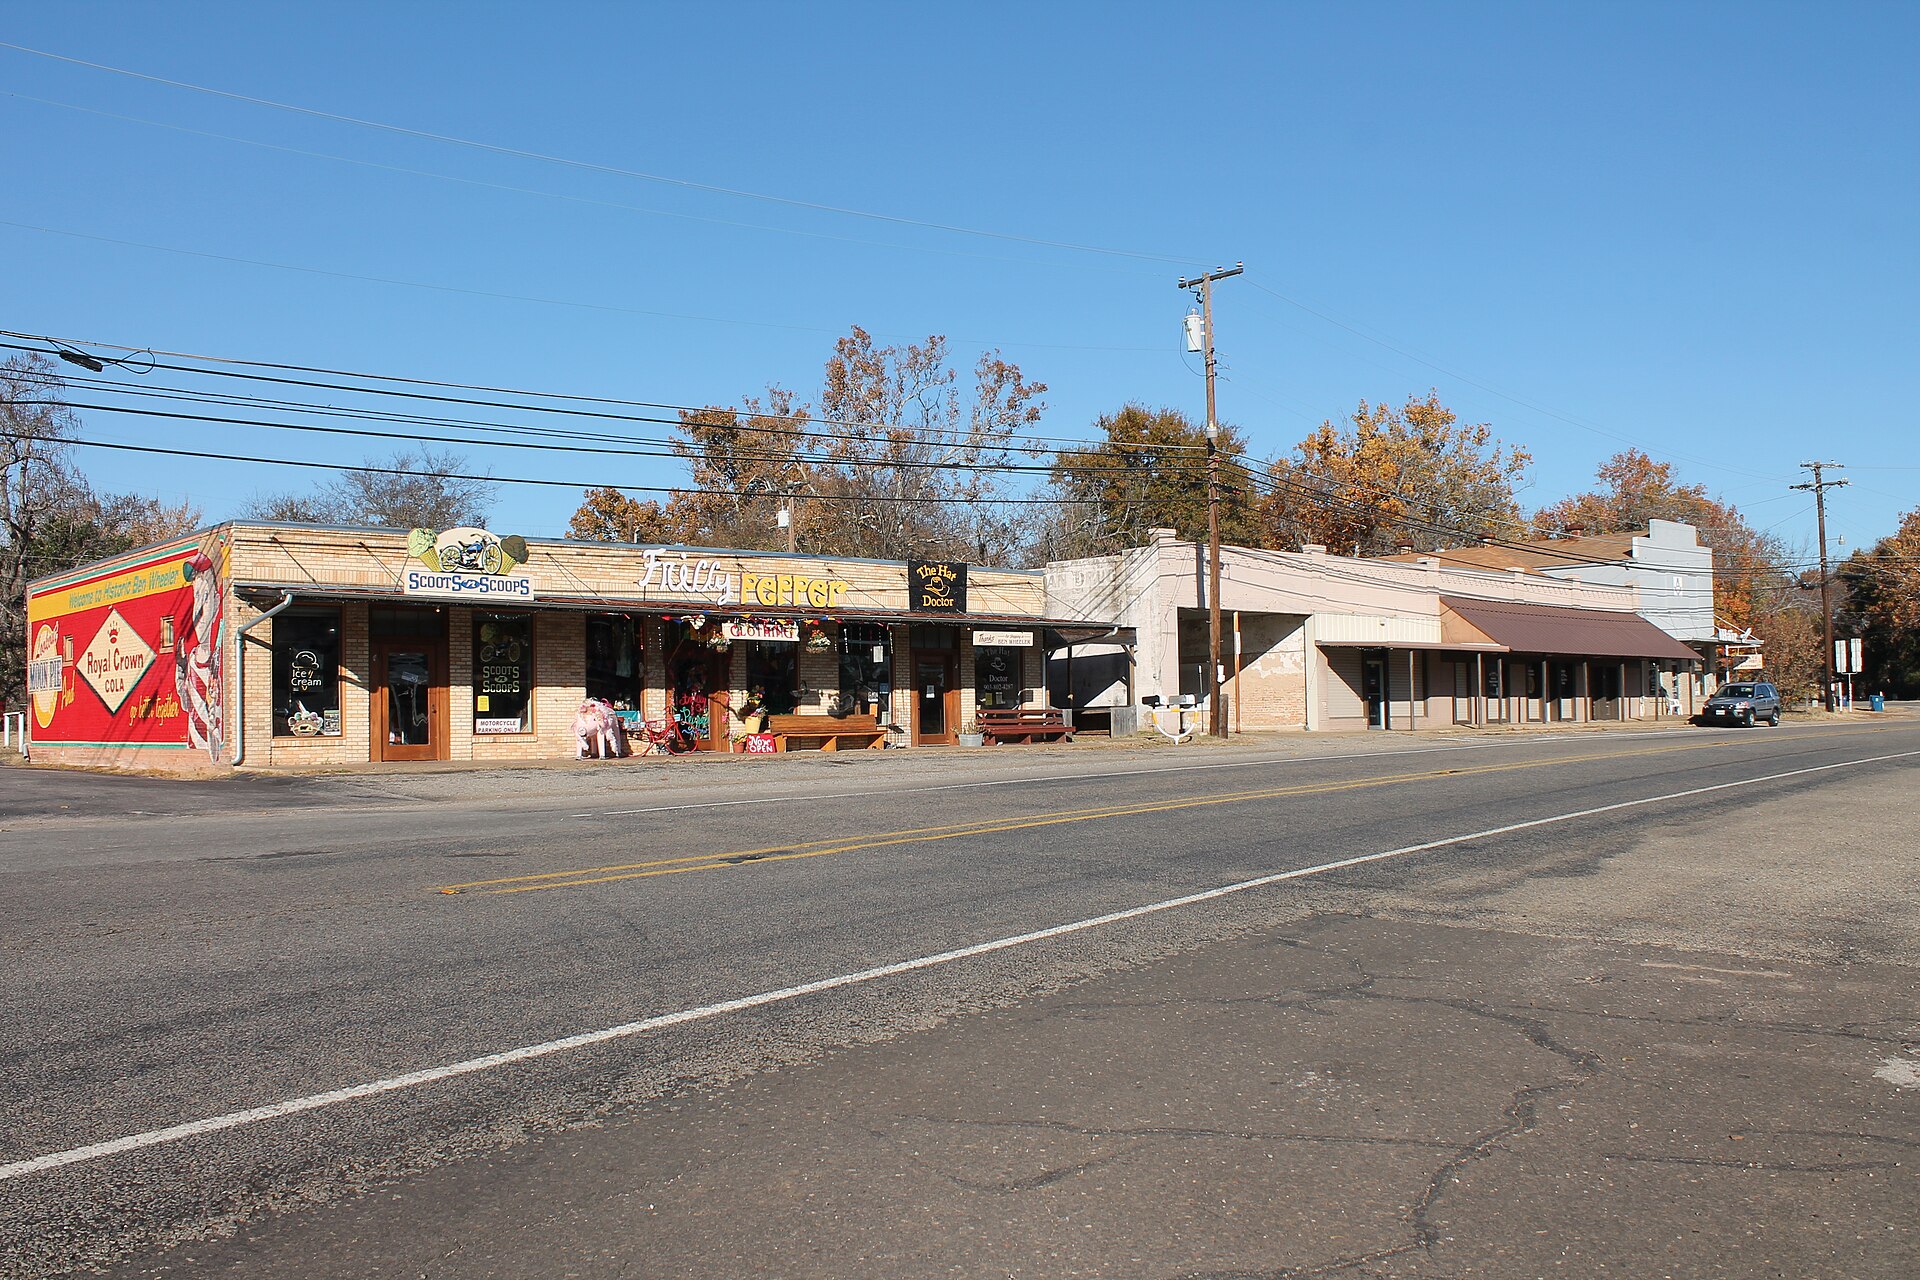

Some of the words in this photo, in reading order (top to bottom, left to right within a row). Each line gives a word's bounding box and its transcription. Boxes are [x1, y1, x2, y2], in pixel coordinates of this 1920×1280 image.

[638, 547, 735, 606] Frilly
[916, 564, 937, 579] The
[69, 591, 94, 608] Welcome
[102, 578, 131, 599] Historic
[132, 575, 147, 593] Ben
[149, 567, 179, 590] Wheeler
[922, 595, 954, 607] Doctor
[87, 649, 111, 679] Royal
[113, 648, 144, 671] Crown
[29, 662, 49, 690] MOON
[49, 660, 61, 688] PIE
[292, 669, 307, 678] Ice
[104, 678, 125, 693] COLA
[291, 677, 322, 686] Cream
[483, 681, 520, 693] SCOOPS
[748, 734, 771, 746] Now
[749, 745, 773, 753] OPEN
